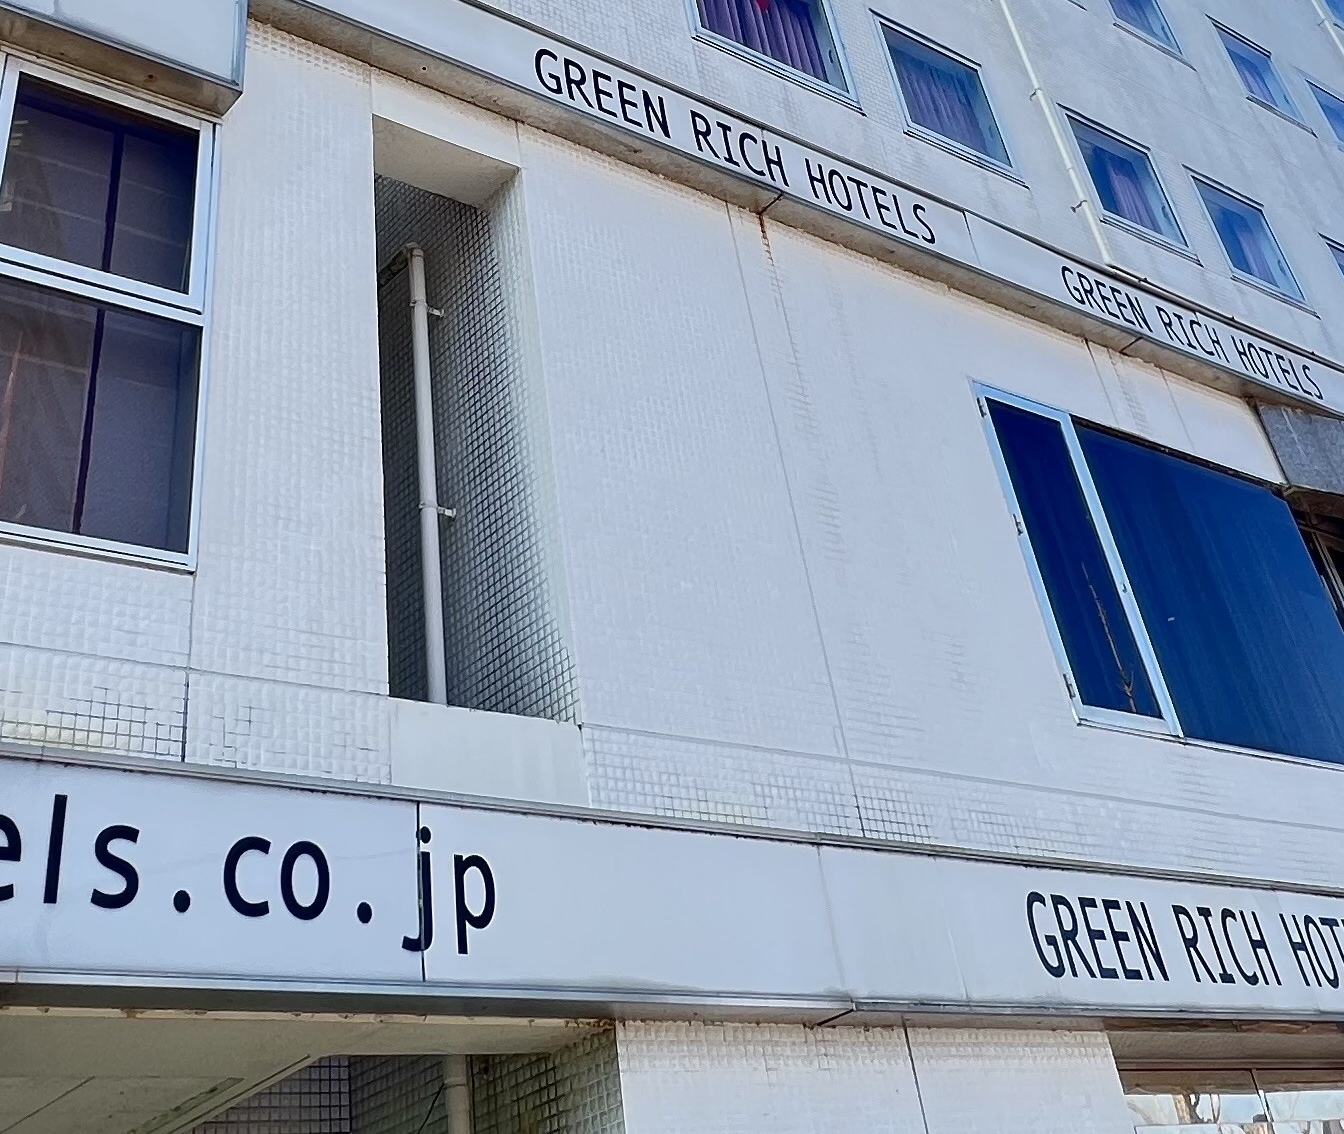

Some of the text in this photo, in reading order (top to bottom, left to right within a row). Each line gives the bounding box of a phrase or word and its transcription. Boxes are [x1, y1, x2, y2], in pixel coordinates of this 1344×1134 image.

[534, 48, 936, 245] GREEN RICH HOTELS
[1061, 266, 1324, 401] GREEN RICH HOTELS
[1026, 890, 1170, 982] GREEN
[1173, 903, 1283, 987] RICH
